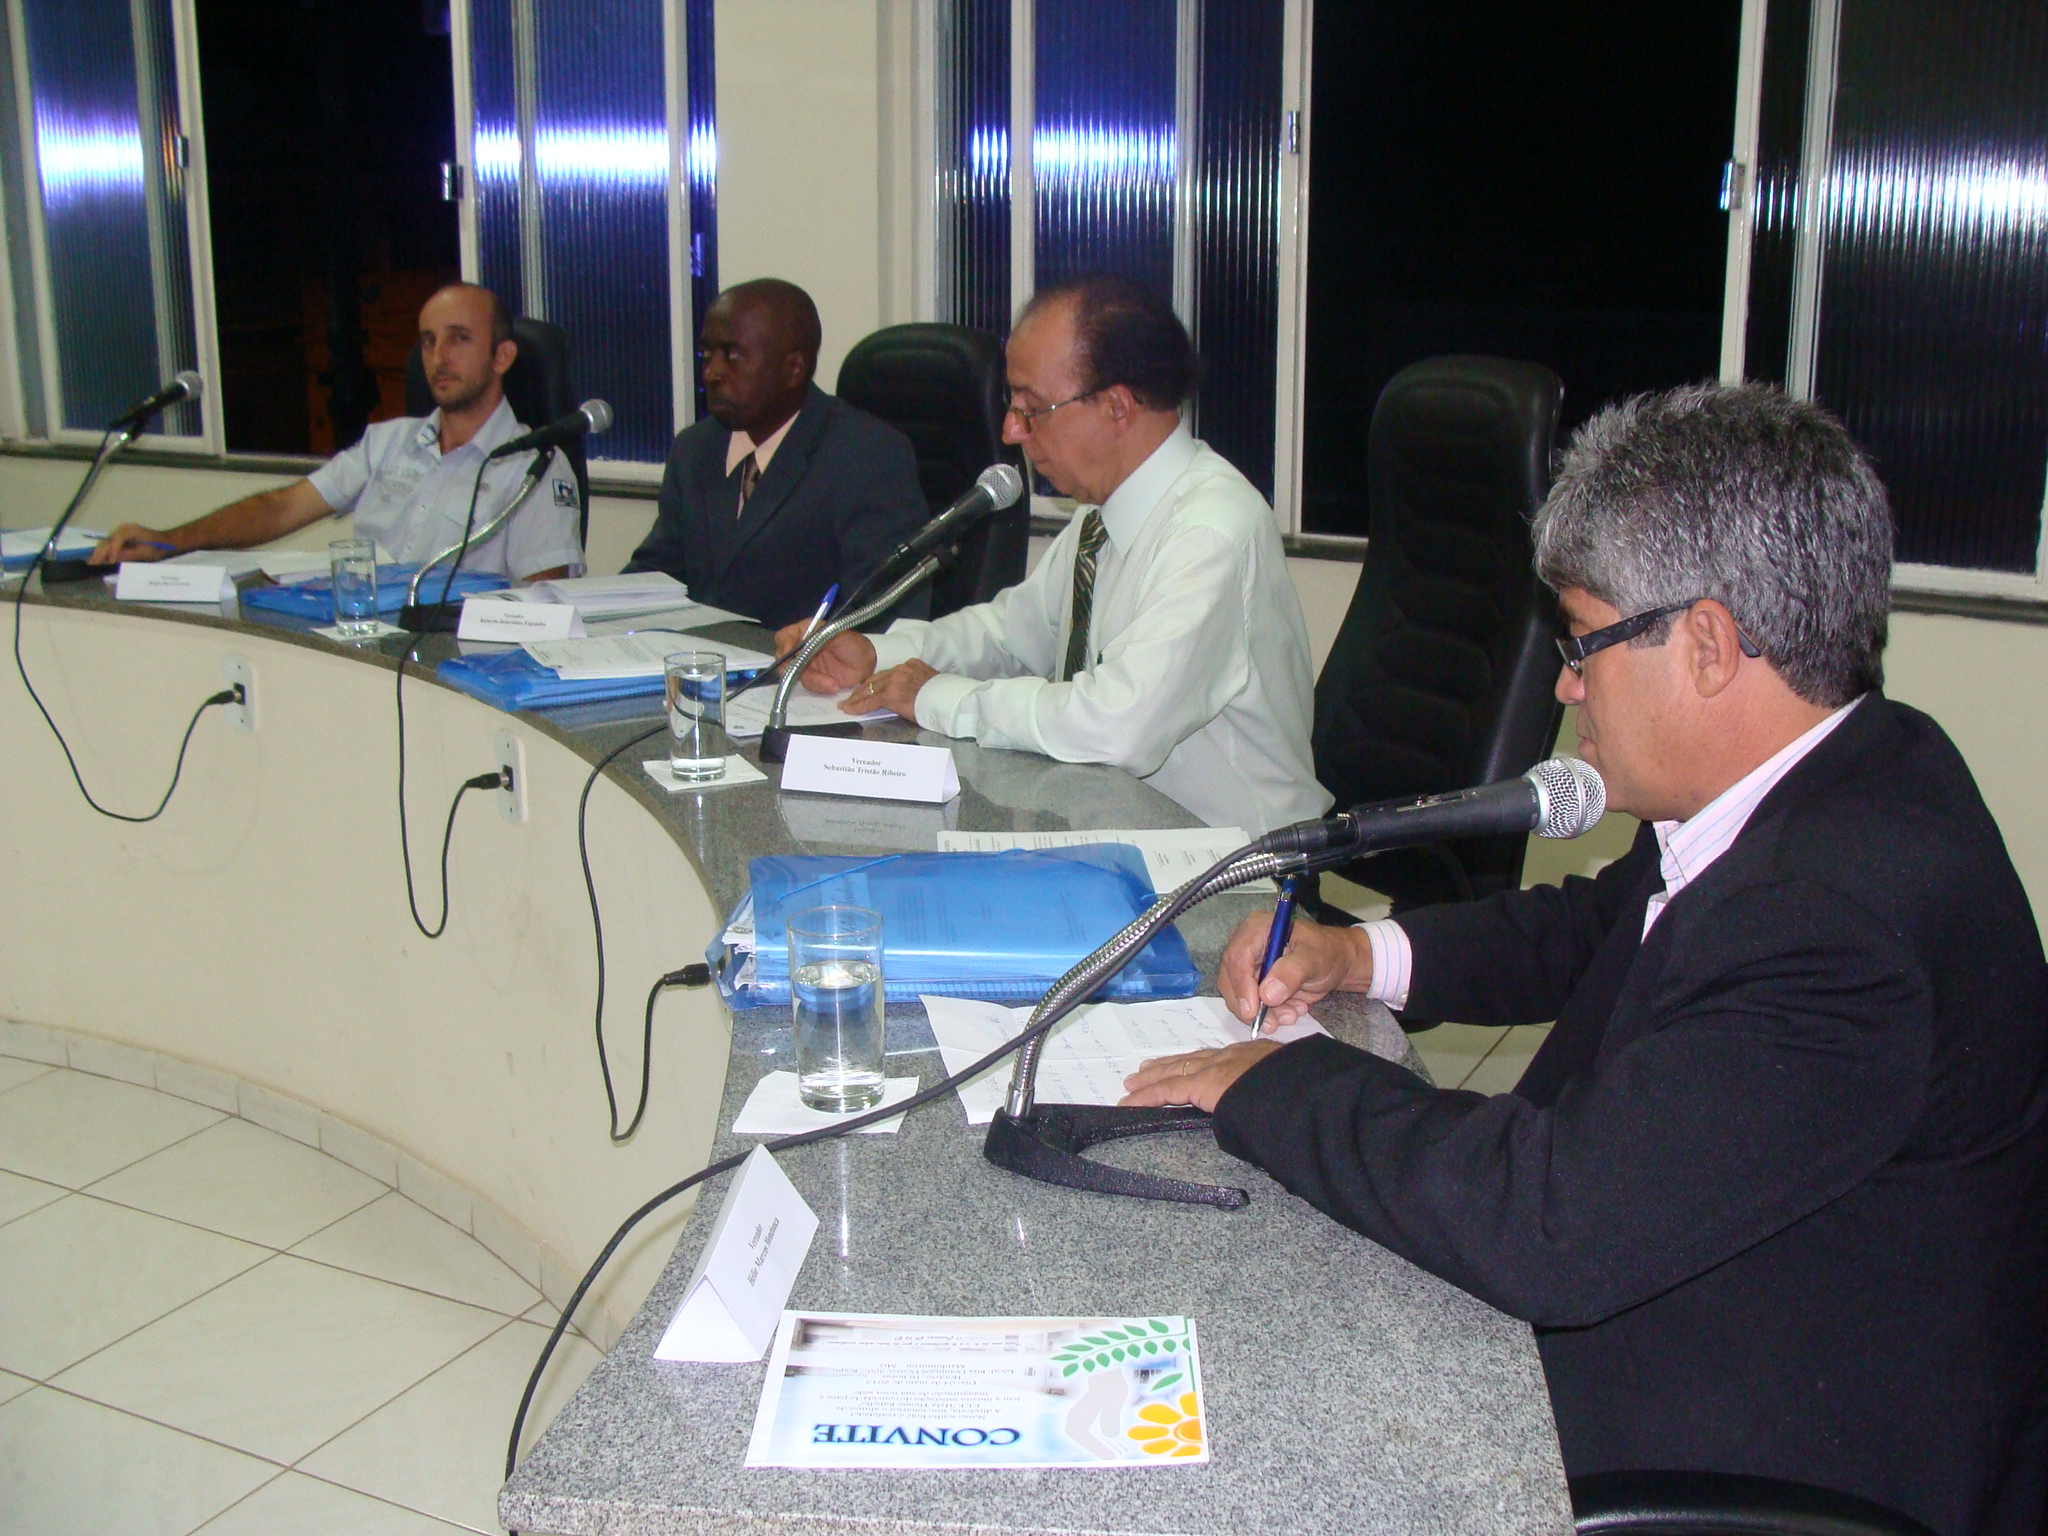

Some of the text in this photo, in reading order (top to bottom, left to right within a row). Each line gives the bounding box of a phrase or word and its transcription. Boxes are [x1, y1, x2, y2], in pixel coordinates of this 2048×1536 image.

[852, 757, 882, 766] Vereador
[823, 763, 907, 778] Sebastião Tristão Ribeiro
[813, 1424, 1020, 1445] CONVITE
